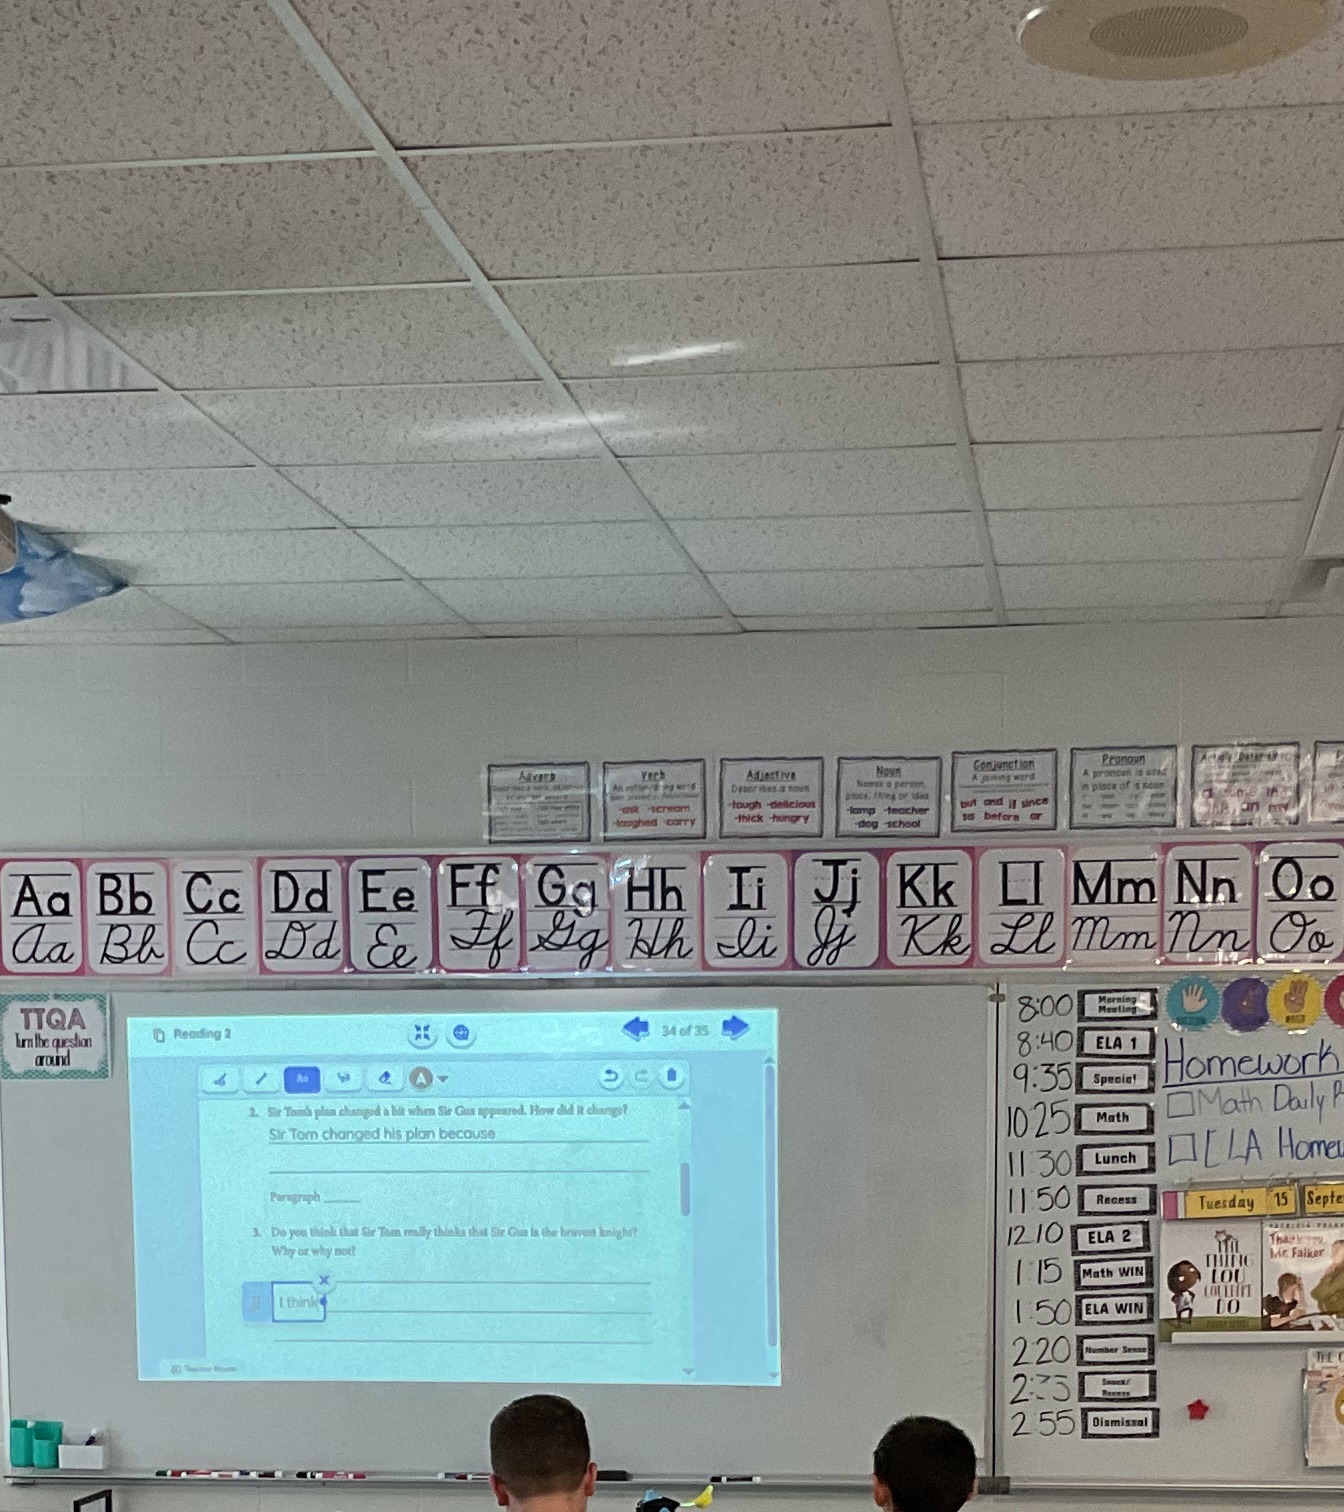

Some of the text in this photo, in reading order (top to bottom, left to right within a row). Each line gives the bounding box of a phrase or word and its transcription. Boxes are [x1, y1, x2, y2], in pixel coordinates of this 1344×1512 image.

[974, 759, 1035, 771] Conjunction
[1102, 754, 1146, 764] Pronoun
[642, 771, 665, 780] Verb
[747, 770, 796, 780] Adjective
[876, 766, 901, 776] Noun
[13, 874, 71, 917] Aa
[99, 873, 153, 915] Bb
[186, 872, 241, 913] Cc
[274, 870, 328, 912] Dd
[362, 869, 415, 911] Ee
[451, 864, 499, 907] Ff
[538, 864, 596, 917] Gg
[627, 867, 683, 911] Hh
[728, 867, 764, 909] Ii
[814, 859, 858, 917] Jj
[899, 864, 957, 907] Kk
[1002, 862, 1041, 905] Ll
[1074, 860, 1156, 904] Mm
[1177, 859, 1237, 903] Nn
[1272, 857, 1334, 900] Oo
[1098, 995, 1137, 1004] Morning
[1018, 994, 1073, 1022] 8:00
[1098, 1005, 1137, 1014] Meeting
[20, 1007, 86, 1031] TTQA
[174, 1028, 232, 1041] Reading 2
[662, 1023, 710, 1036] 34 of 35
[15, 1032, 92, 1054] Turn the question
[1018, 1030, 1073, 1057] 8:40
[1096, 1036, 1137, 1050] ELA 1
[35, 1049, 70, 1066] around
[1164, 1037, 1340, 1084] Homework
[1013, 1062, 1073, 1093] 9:35
[1094, 1073, 1137, 1086] Special
[1198, 1086, 1263, 1116] Math
[1274, 1081, 1326, 1124] Daily
[315, 1105, 337, 1120] plan
[339, 1105, 381, 1120] changed
[408, 1105, 436, 1116] when
[530, 1104, 554, 1116] How
[557, 1104, 574, 1116] did
[1096, 1112, 1130, 1123] Math
[269, 1127, 496, 1143] Sir Tom changed his plan because
[1095, 1151, 1137, 1164] Lunch
[269, 1190, 320, 1204] Paragraph
[1097, 1194, 1137, 1205] Recess
[1199, 1194, 1255, 1212] Tuesday
[1274, 1191, 1288, 1207] 15
[1088, 1229, 1131, 1244] ELA 2
[1082, 1266, 1144, 1279] Math WIN
[1085, 1302, 1144, 1315] ELA WIN
[1085, 1346, 1119, 1354] Number
[1316, 1350, 1333, 1363] THE
[1011, 1409, 1075, 1436] 2:55
[1092, 1417, 1148, 1427] Dismissal
